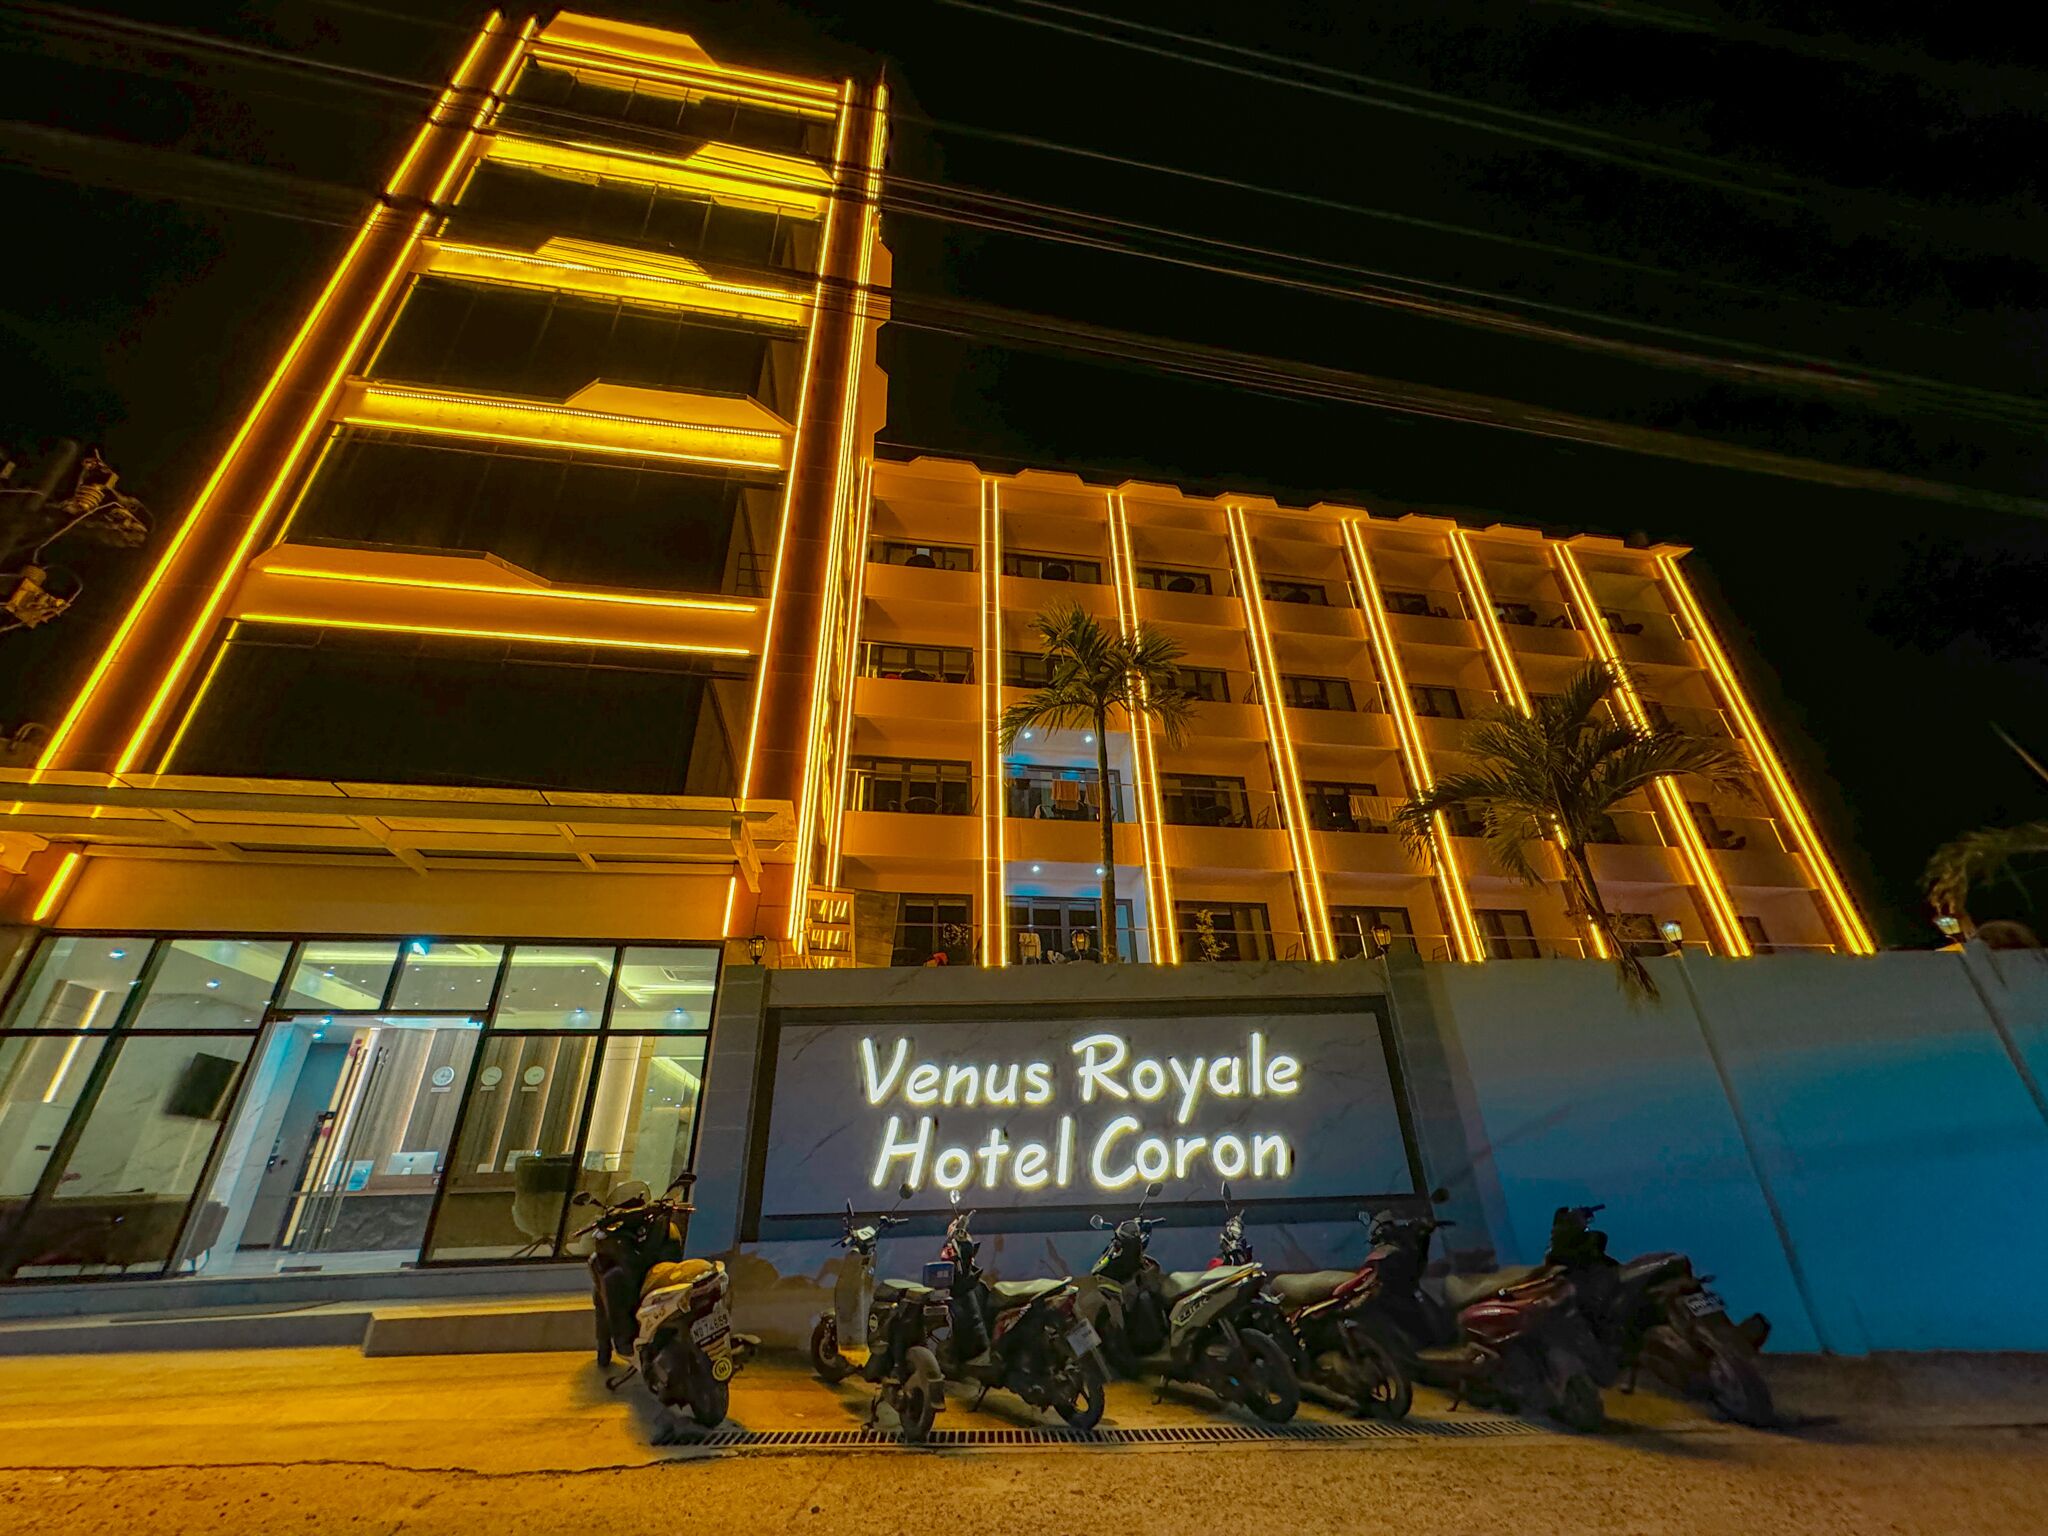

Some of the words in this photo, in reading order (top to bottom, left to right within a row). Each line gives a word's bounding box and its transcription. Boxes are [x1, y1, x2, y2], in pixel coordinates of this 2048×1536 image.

[861, 1036, 1052, 1106] Venus
[1071, 1031, 1301, 1125] Royale
[871, 1114, 1072, 1190] Hotel
[1090, 1114, 1289, 1190] Coron
